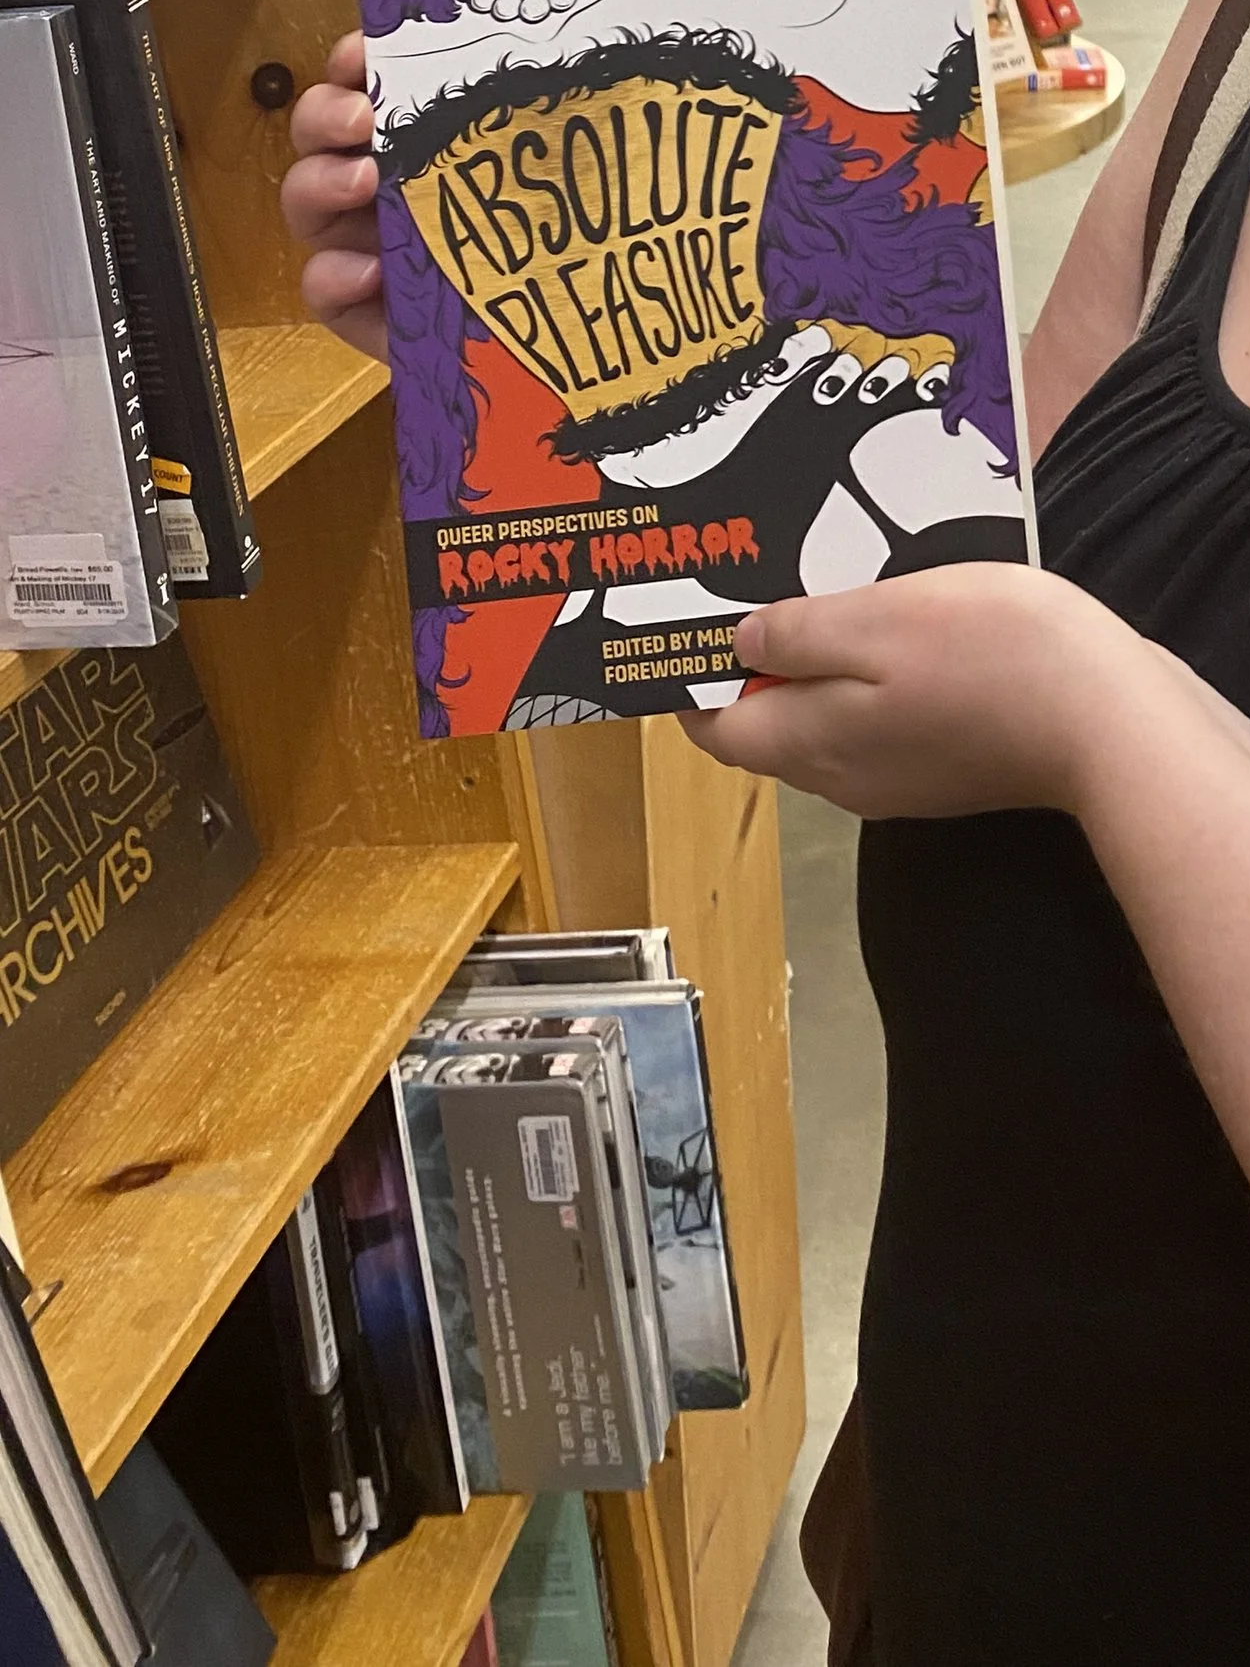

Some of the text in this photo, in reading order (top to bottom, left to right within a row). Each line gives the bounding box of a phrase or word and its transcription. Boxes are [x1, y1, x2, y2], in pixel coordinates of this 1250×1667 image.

[68, 41, 80, 76] WARD
[438, 97, 770, 296] ABSOLUTE
[142, 30, 153, 66] THE
[149, 71, 161, 101] ART
[157, 107, 167, 130] OF
[163, 134, 174, 172] MISS
[191, 278, 206, 325] HOME
[201, 327, 213, 361] FOR
[209, 364, 228, 439] PECULIAR
[224, 441, 246, 518] CHILDREN
[85, 136, 159, 516] THE ART AND MAKING OF MICKEY 17
[484, 217, 756, 395] PLEASURE
[153, 468, 185, 484] COUNT
[437, 504, 659, 550] QUEER PERSPECTIVES ON
[88, 574, 97, 583] 17
[438, 516, 761, 599] ROCKY HORROR
[602, 634, 666, 660] EDITED
[669, 631, 694, 650] BY
[604, 651, 735, 685] FOREWORD BY
[0, 691, 157, 939] ARS
[555, 1403, 570, 1415] a
